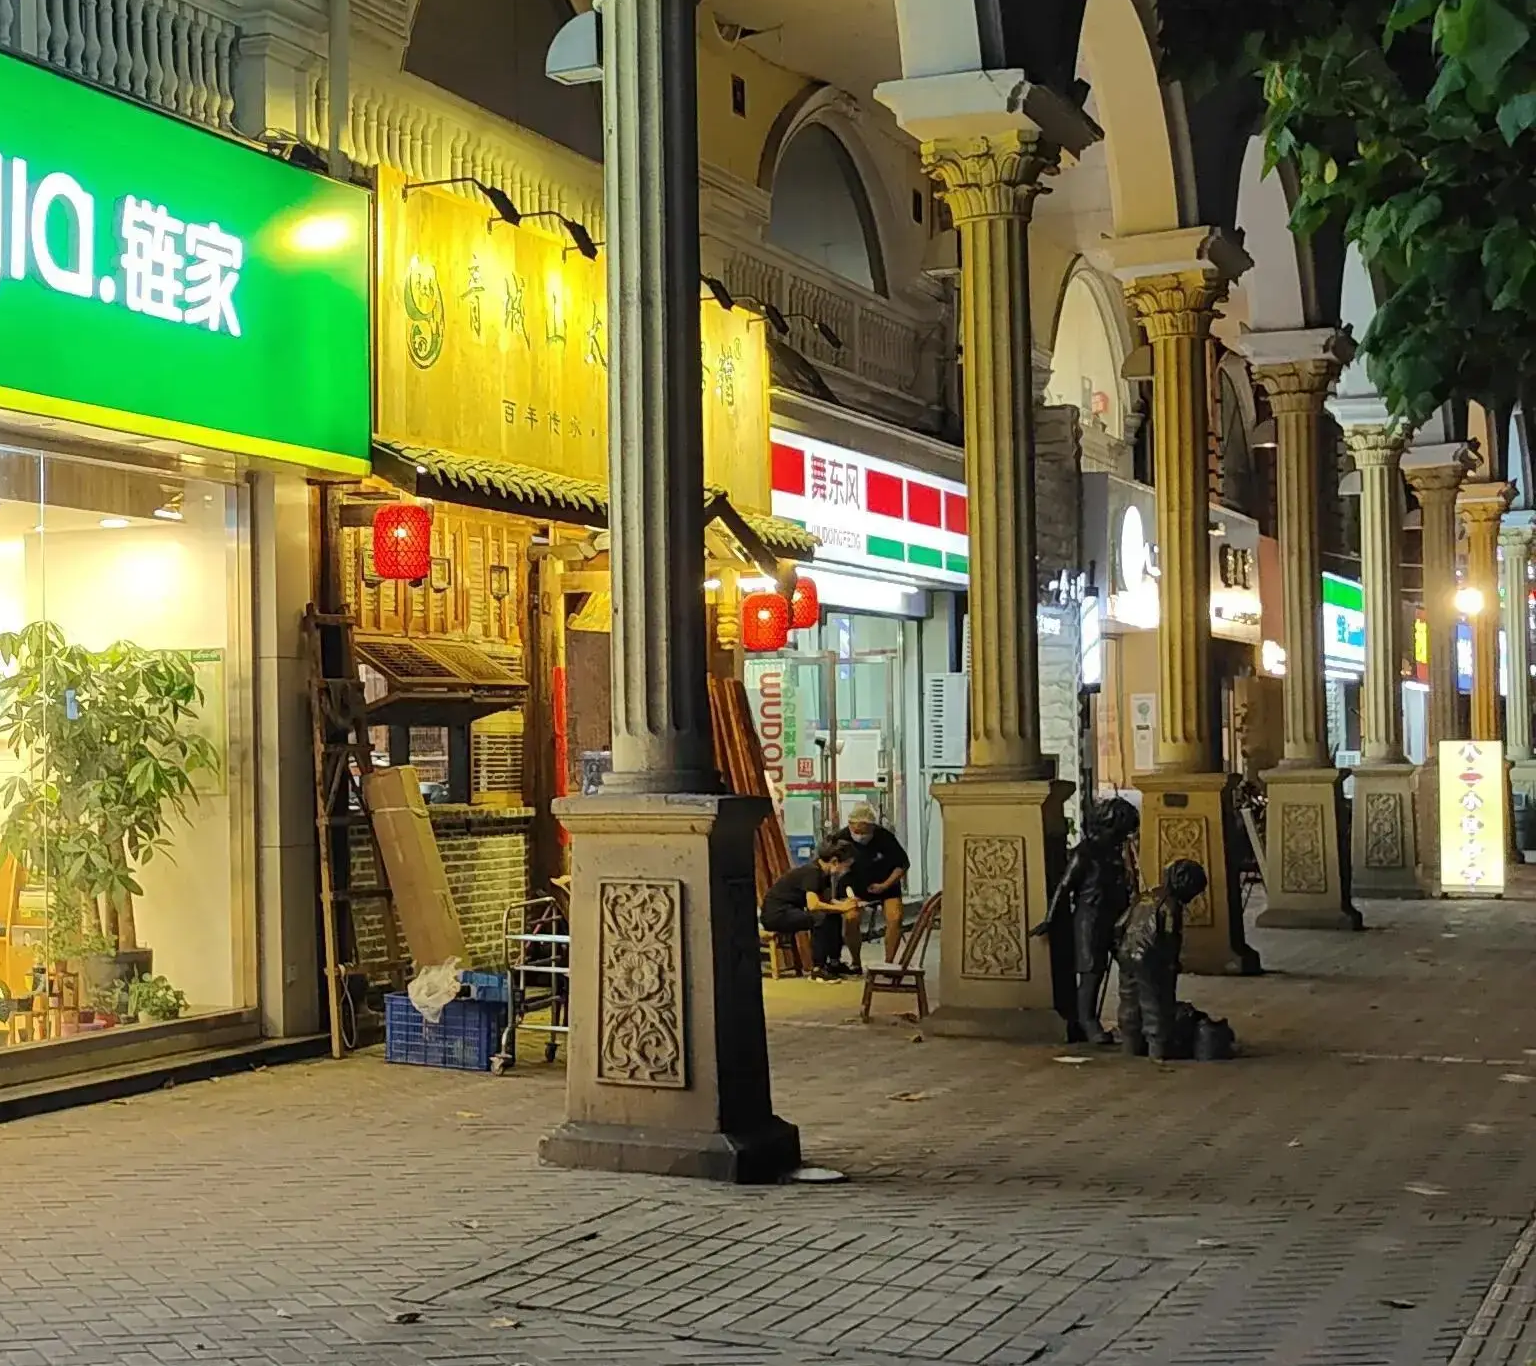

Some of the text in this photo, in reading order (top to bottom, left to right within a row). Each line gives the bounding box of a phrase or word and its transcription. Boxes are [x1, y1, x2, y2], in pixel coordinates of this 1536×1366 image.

[119, 193, 243, 338] 链家
[810, 452, 861, 511] 舞东风
